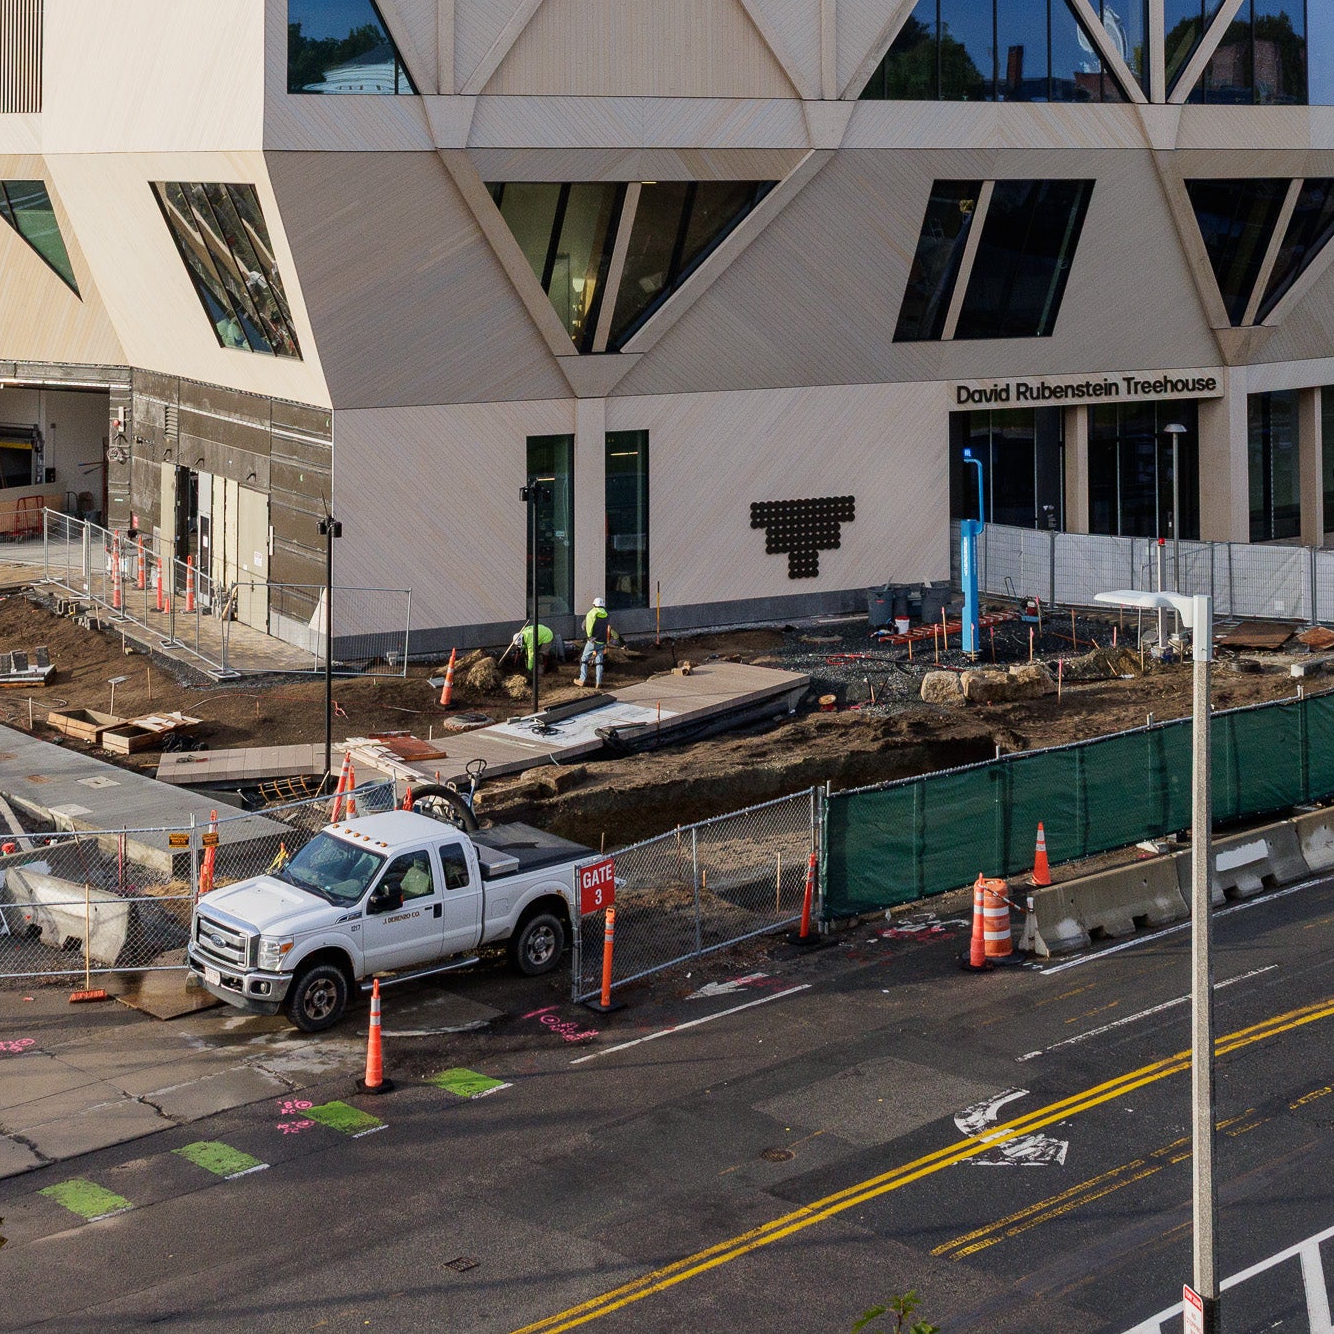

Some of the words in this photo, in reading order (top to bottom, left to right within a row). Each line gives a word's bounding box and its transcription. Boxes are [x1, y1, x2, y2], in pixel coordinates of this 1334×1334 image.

[956, 383, 1010, 404] David
[1016, 377, 1119, 401] Rubenstein
[1122, 375, 1217, 396] Treehouse
[583, 864, 613, 889] GATE
[595, 888, 603, 905] 3
